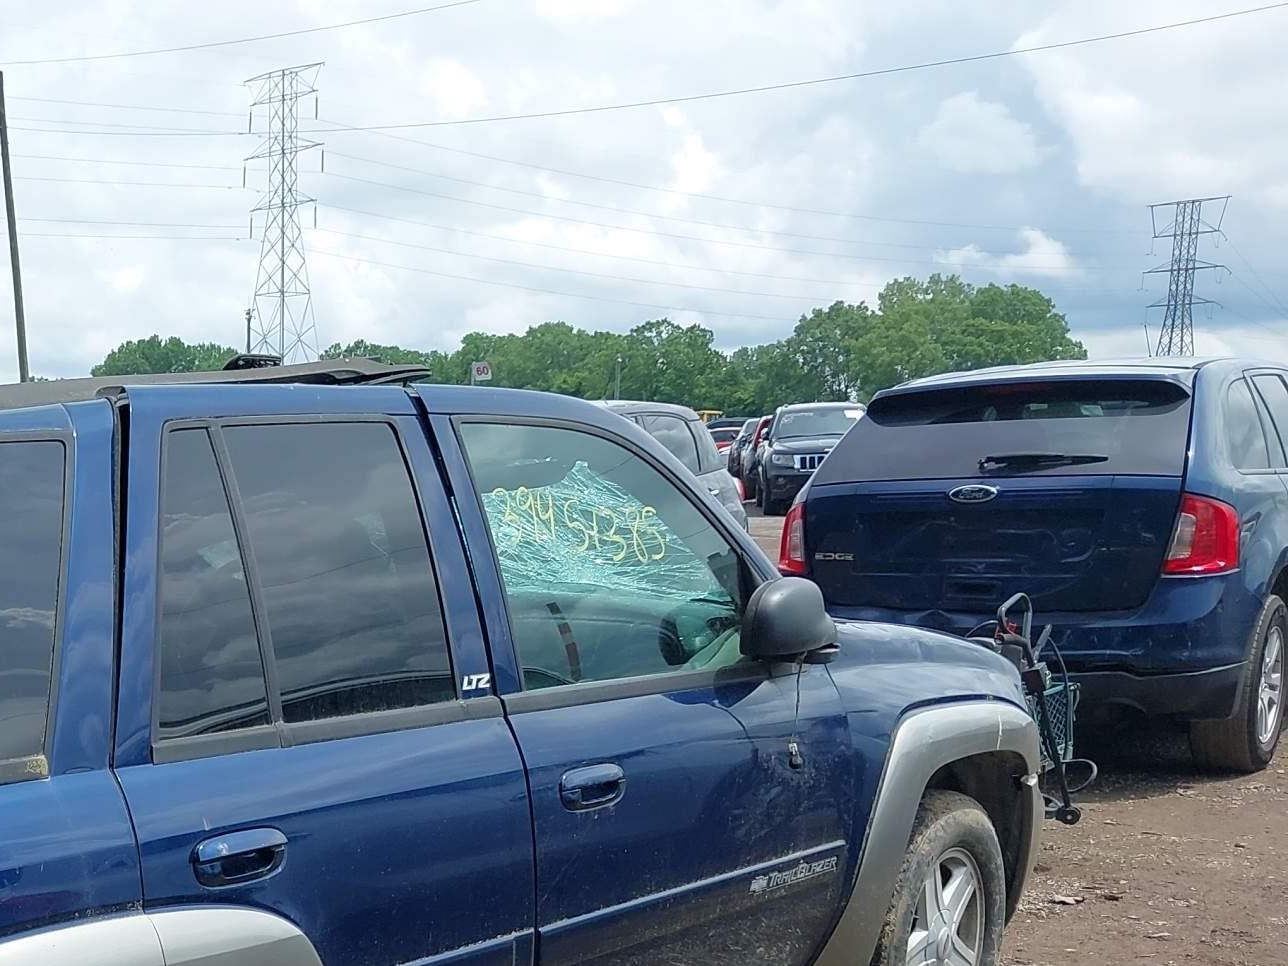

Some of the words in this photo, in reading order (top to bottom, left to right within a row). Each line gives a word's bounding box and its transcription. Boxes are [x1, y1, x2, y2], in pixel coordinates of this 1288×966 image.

[476, 366, 489, 376] 60
[814, 552, 855, 561] EDGE
[462, 672, 490, 691] LTZ
